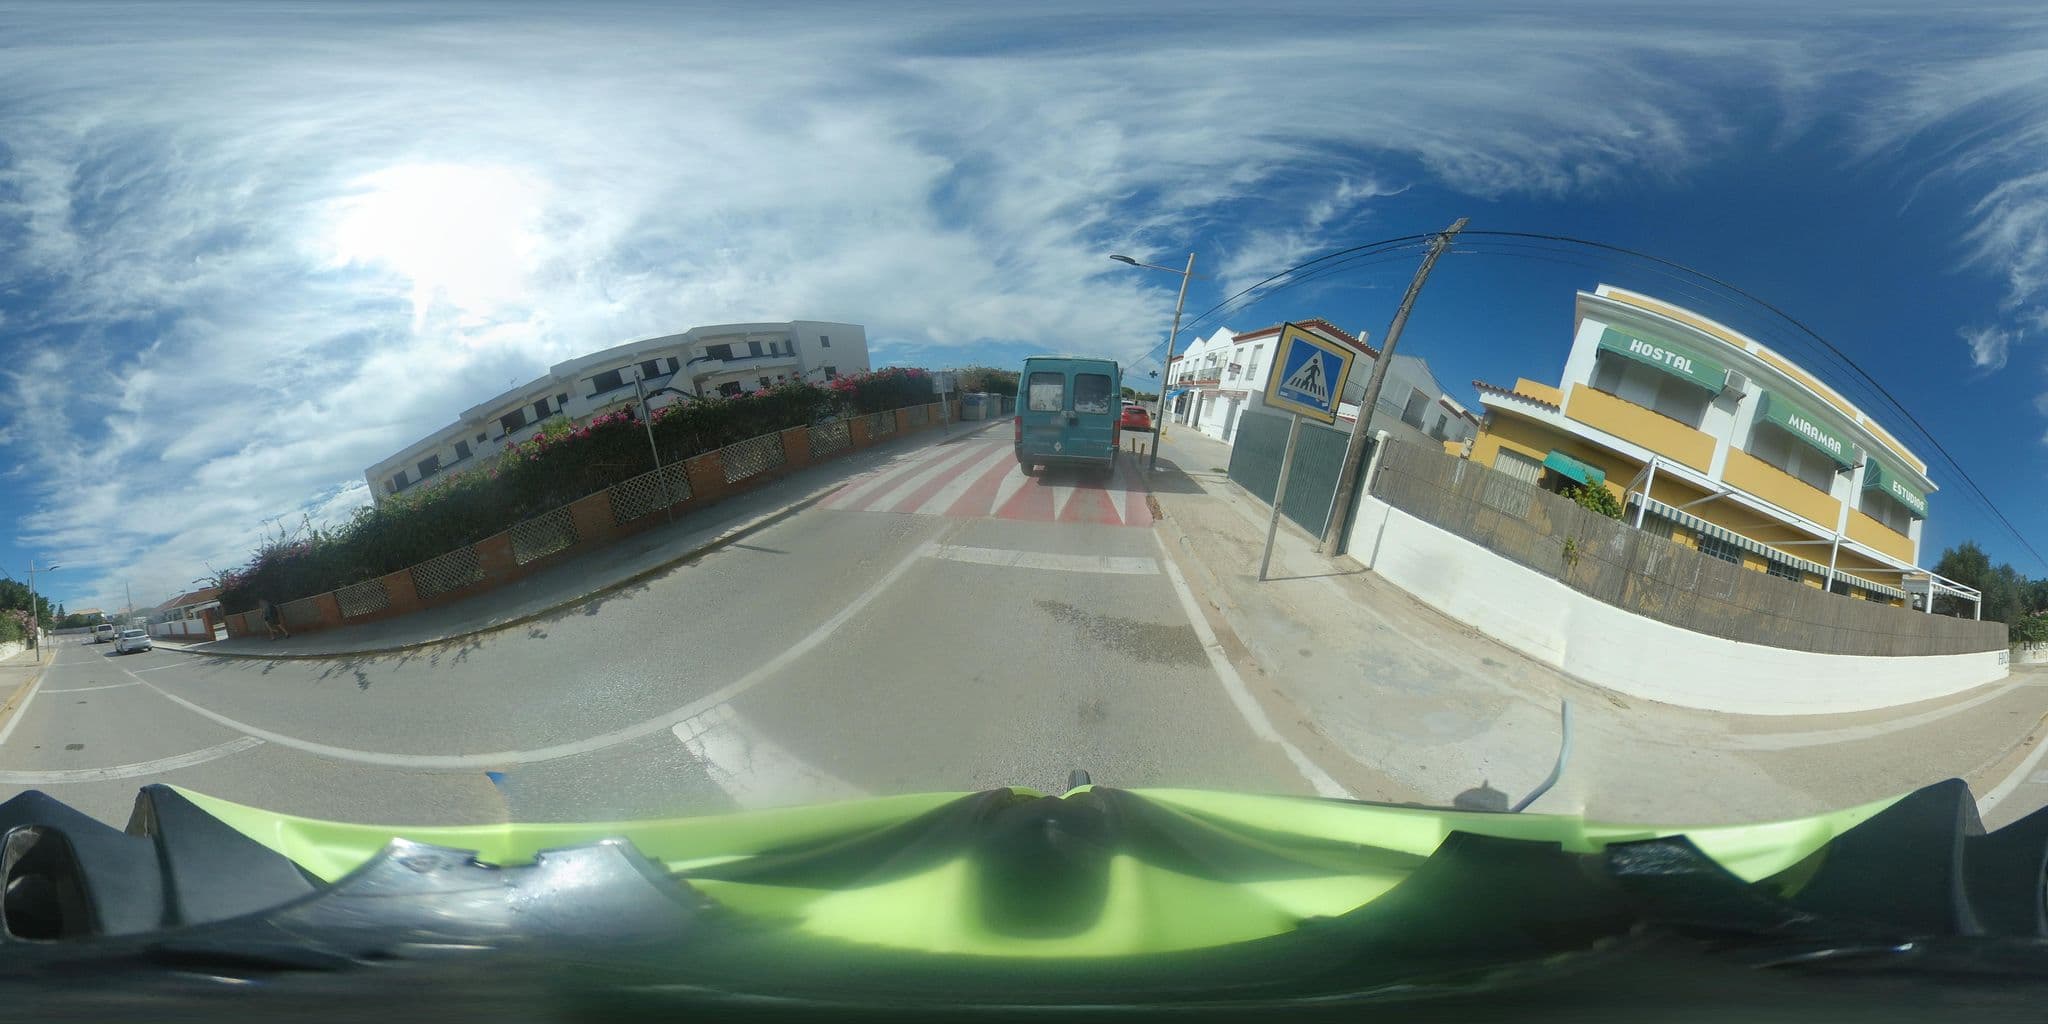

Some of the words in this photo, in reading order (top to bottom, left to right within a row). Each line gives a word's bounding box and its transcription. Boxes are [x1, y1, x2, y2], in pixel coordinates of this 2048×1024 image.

[1629, 338, 1693, 374] HOSTAL
[1788, 413, 1841, 455] MIRAMAR
[1893, 479, 1925, 511] ESTUDIOS
